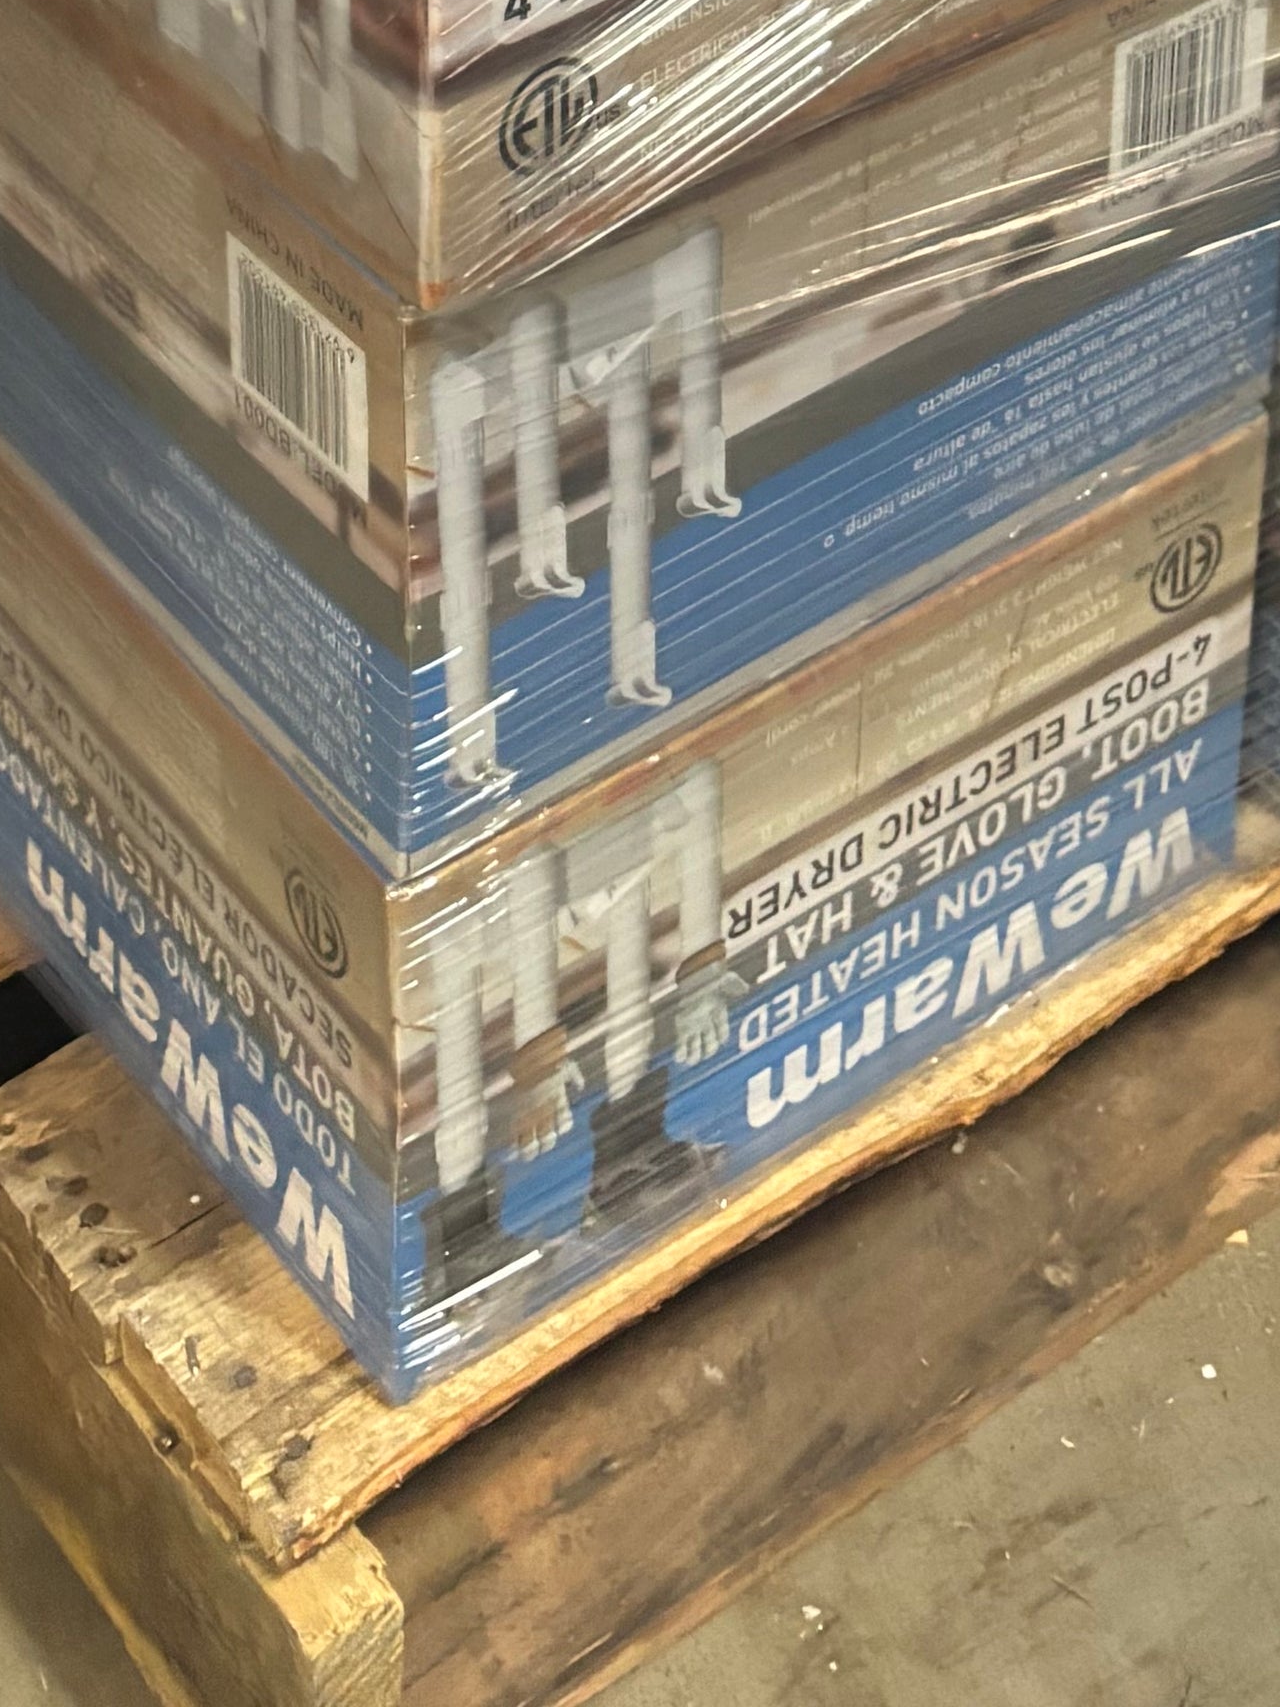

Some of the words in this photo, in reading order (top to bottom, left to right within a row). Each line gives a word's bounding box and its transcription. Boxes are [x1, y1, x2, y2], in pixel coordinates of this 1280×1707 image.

[1080, 678, 1210, 783] BOOT,
[1081, 632, 1213, 730] 4-POST
[876, 713, 1066, 849] ELECTRIC
[915, 767, 1068, 879] GLOVE
[1123, 737, 1204, 811] ALL
[726, 831, 865, 938] DRYER
[868, 861, 904, 901] &
[934, 796, 1111, 930] SEASON
[737, 909, 920, 1054] HEATED
[745, 806, 1196, 1130] WeWarm
[757, 889, 853, 983] HAT
[26, 836, 355, 1319] WeWarm
